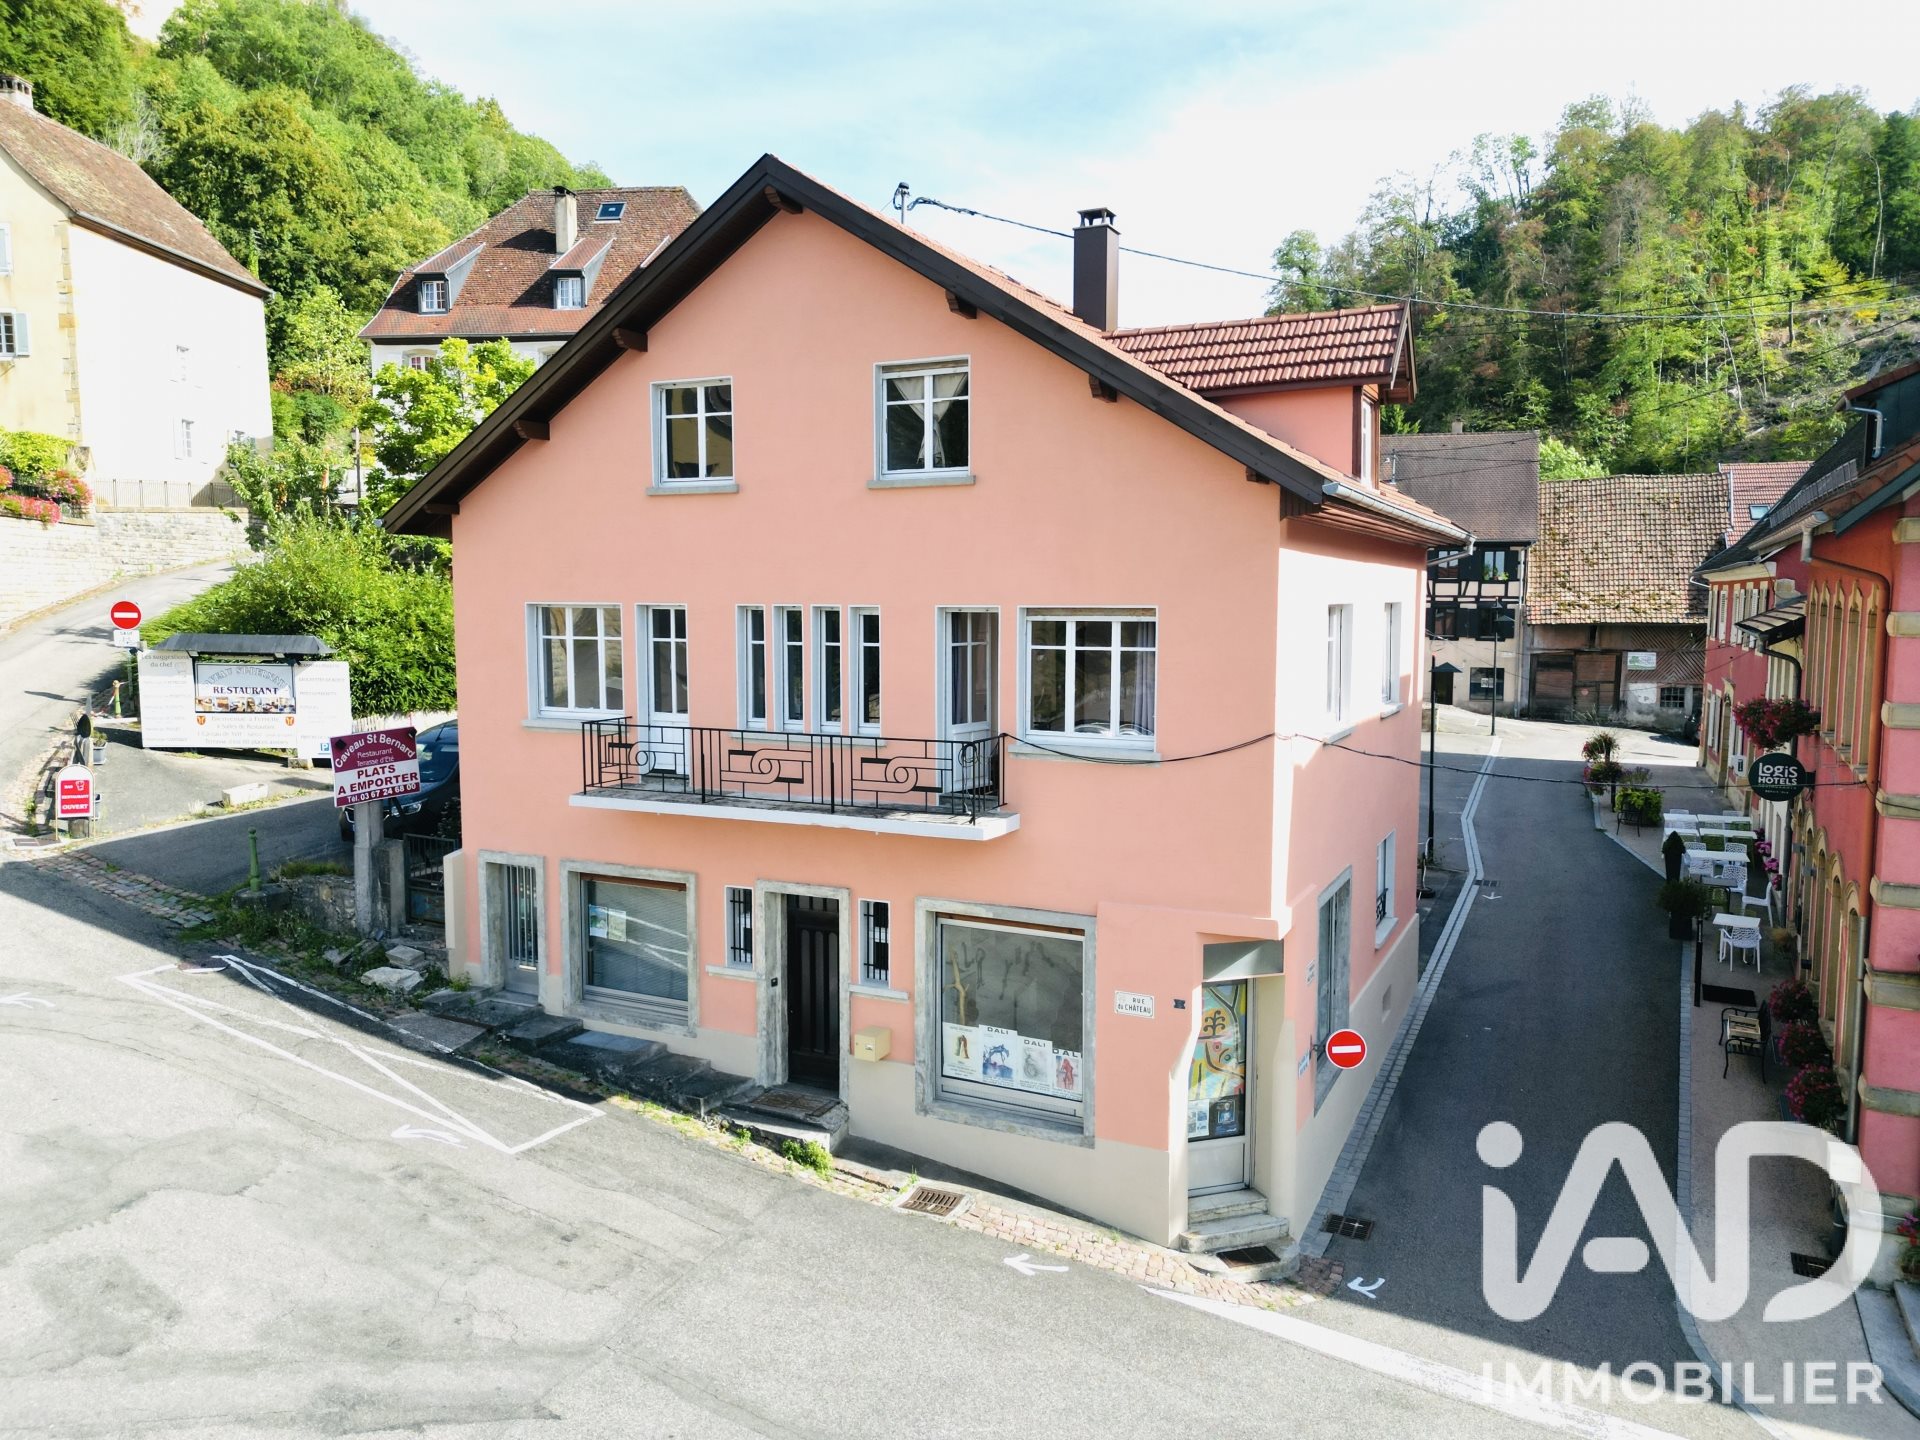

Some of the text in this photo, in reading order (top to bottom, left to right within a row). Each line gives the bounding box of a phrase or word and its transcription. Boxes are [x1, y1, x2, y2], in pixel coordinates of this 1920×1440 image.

[213, 686, 279, 694] RESTAURANT
[335, 734, 415, 768] Caveau St Bernard
[357, 748, 393, 758] Restaurant
[357, 765, 396, 779] PLATS
[338, 772, 418, 795] A EMPORTER
[1758, 776, 1798, 785] HOTELS
[347, 795, 359, 803] Tél.
[360, 792, 369, 800] 03
[371, 791, 380, 799] 67
[383, 788, 392, 796] 24
[406, 783, 416, 791] 00
[1125, 1005, 1151, 1013] CHÂTEAU
[987, 1026, 1009, 1035] DALI
[1024, 1039, 1046, 1048] DALI
